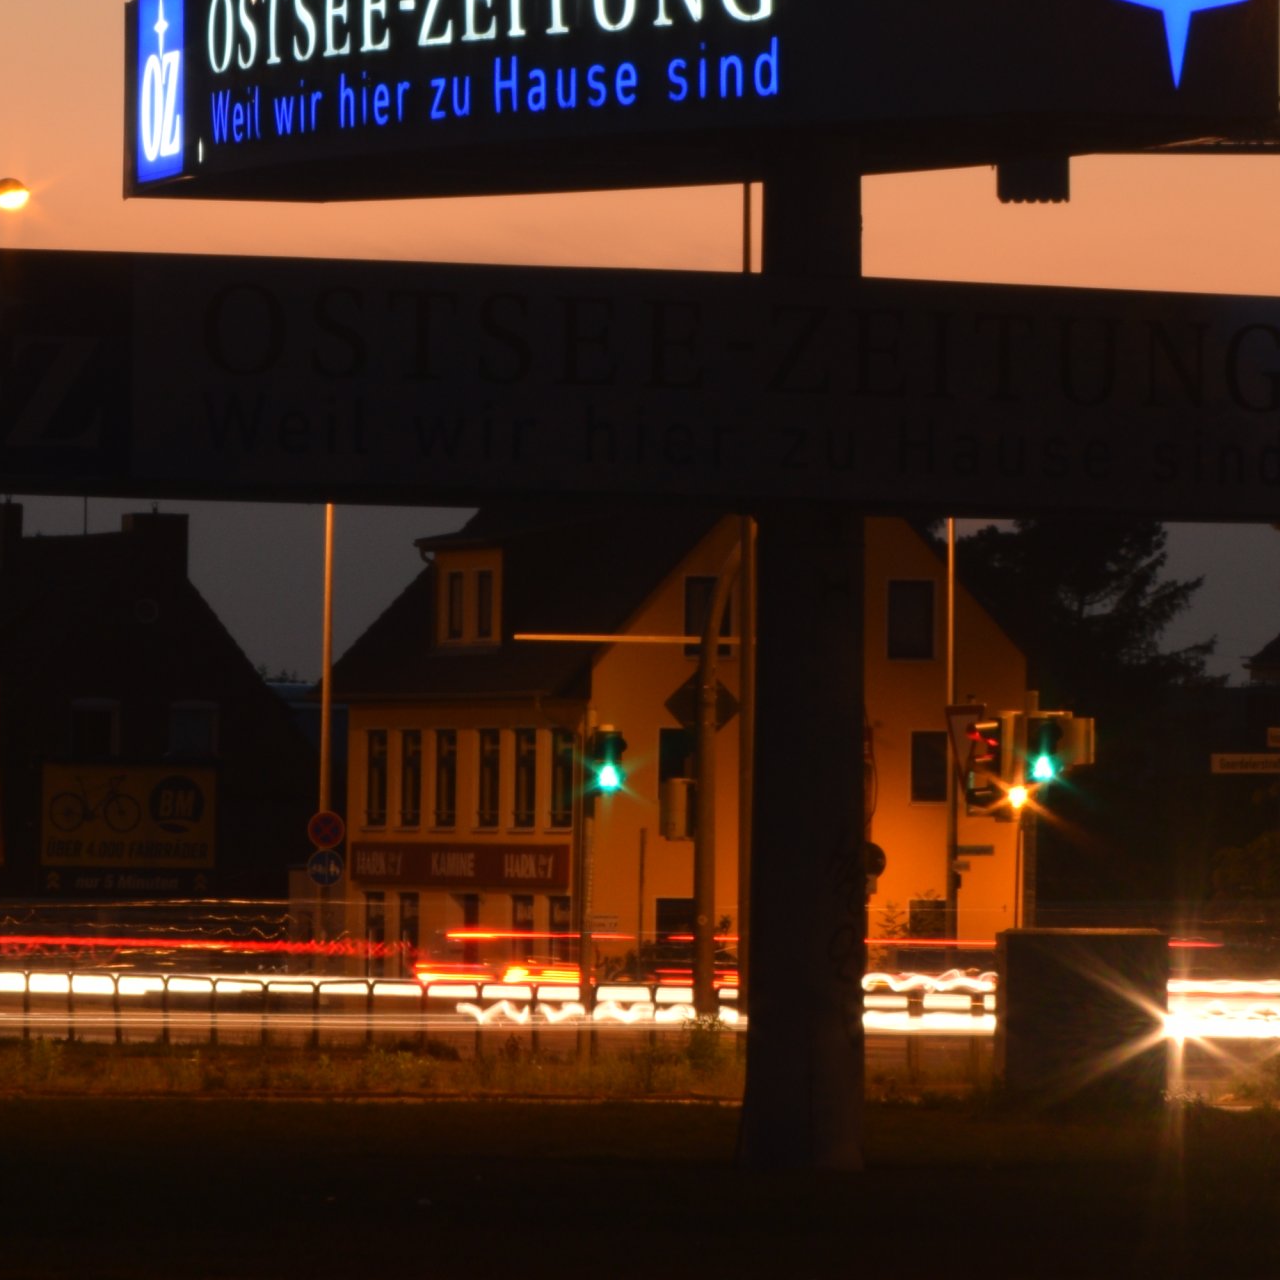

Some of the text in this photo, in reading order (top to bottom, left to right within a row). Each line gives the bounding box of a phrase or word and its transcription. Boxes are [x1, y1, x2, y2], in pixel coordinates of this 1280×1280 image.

[141, 50, 182, 161] OZ
[211, 36, 779, 145] Weil wir hier zu Hause sind
[202, 391, 368, 457] Weil
[412, 400, 537, 463] wir
[584, 405, 728, 467] hier
[779, 427, 856, 473] zu
[899, 414, 1112, 482] Hause
[159, 789, 196, 818] BM
[75, 875, 101, 889] nur
[117, 875, 179, 890] Minuten
[431, 852, 475, 877] KAMINE
